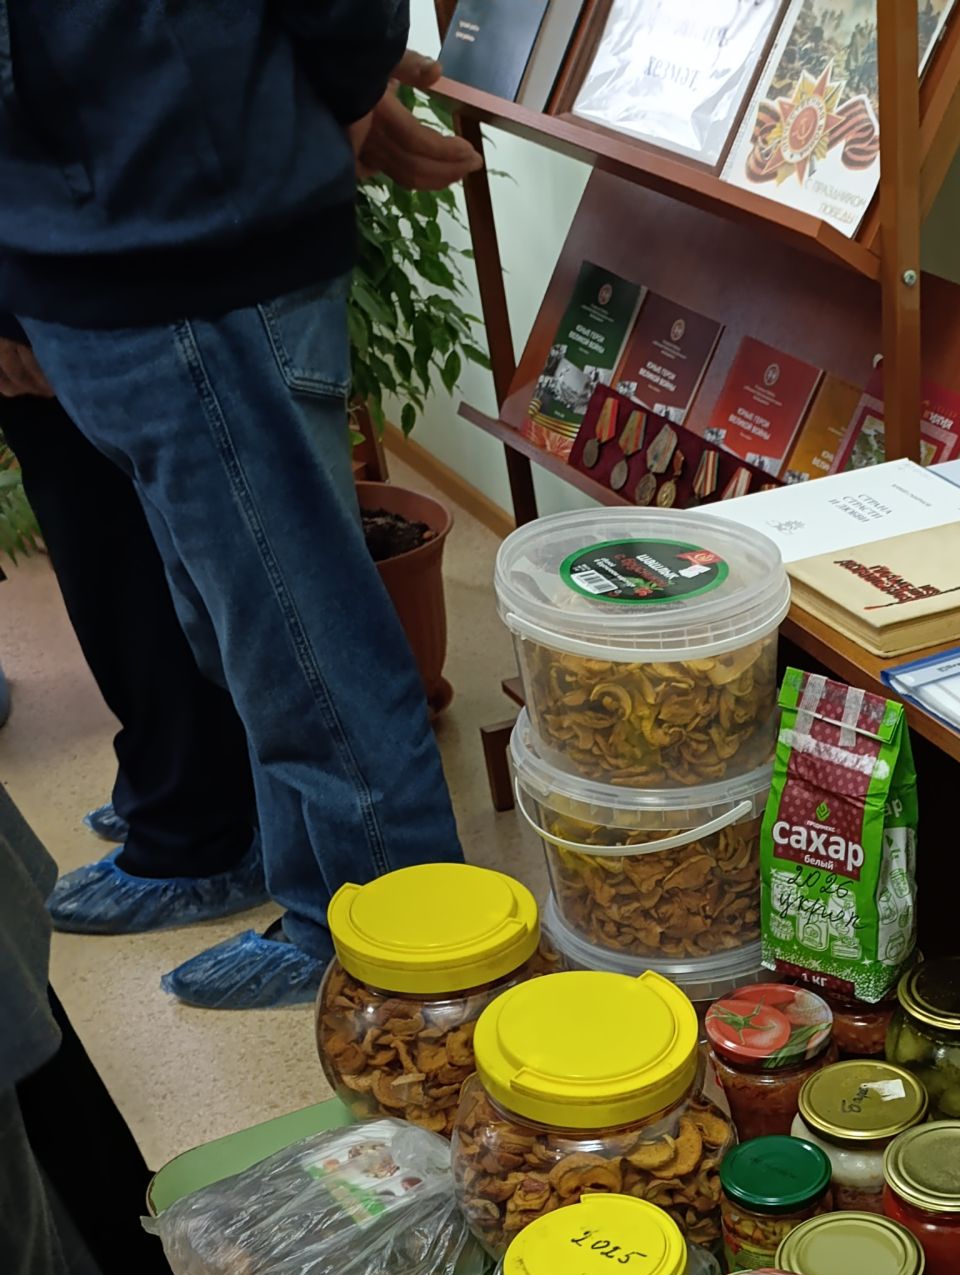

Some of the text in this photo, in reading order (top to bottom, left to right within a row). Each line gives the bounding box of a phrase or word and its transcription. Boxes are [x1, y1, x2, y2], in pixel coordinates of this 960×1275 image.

[772, 820, 865, 872] сахар
[803, 854, 835, 871] белый
[801, 973, 809, 982] 1
[570, 1230, 648, 1264] 2025
